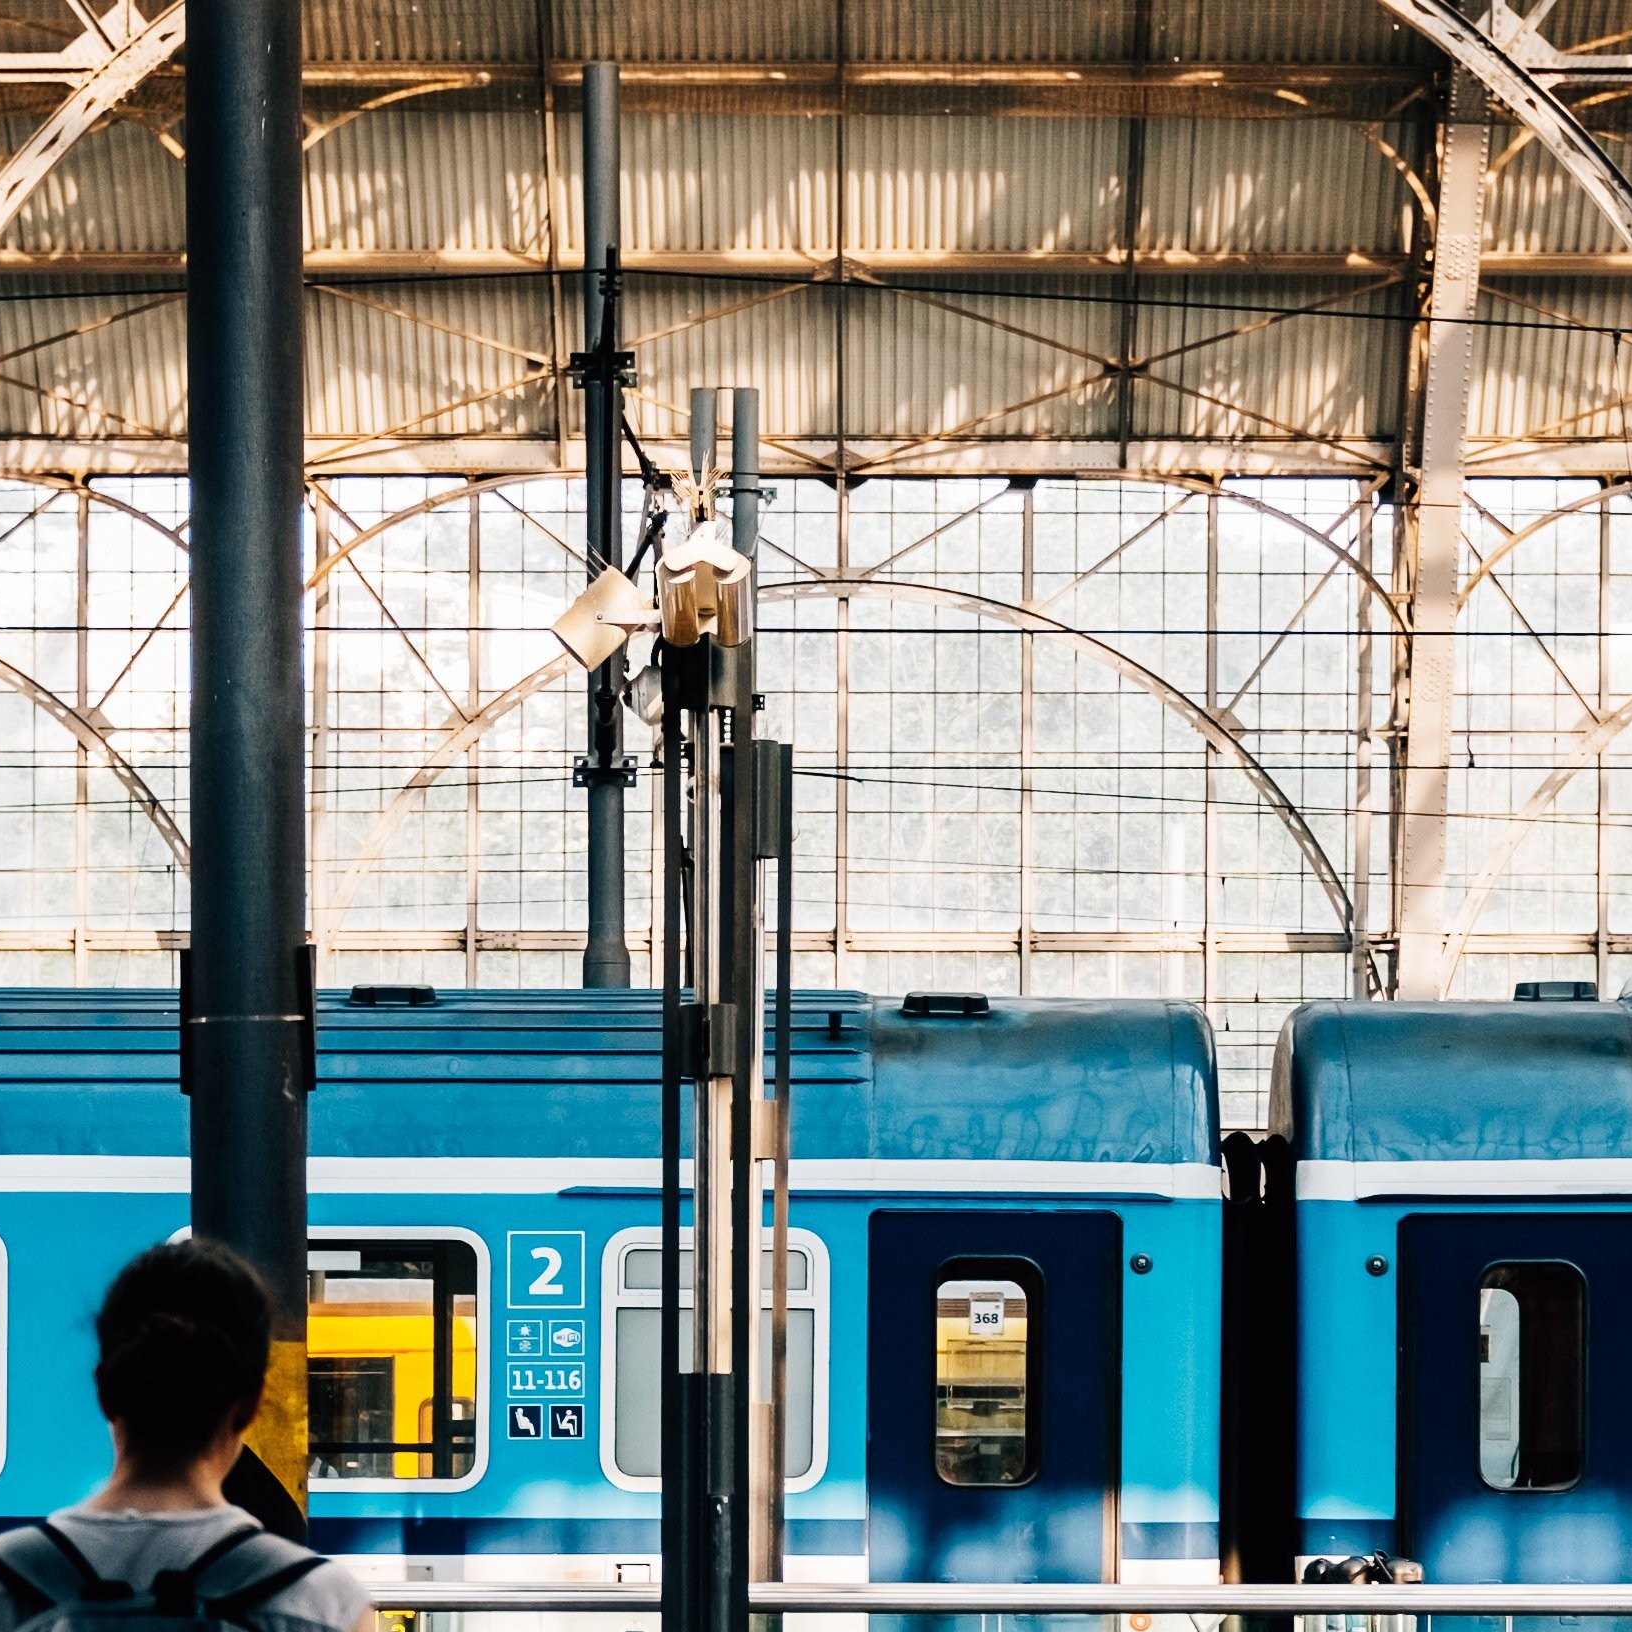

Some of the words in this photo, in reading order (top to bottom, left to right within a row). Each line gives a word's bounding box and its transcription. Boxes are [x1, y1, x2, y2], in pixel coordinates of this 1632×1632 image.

[529, 1247, 564, 1295] 2
[974, 1313, 999, 1324] 368
[512, 1370, 581, 1390] 11-116
